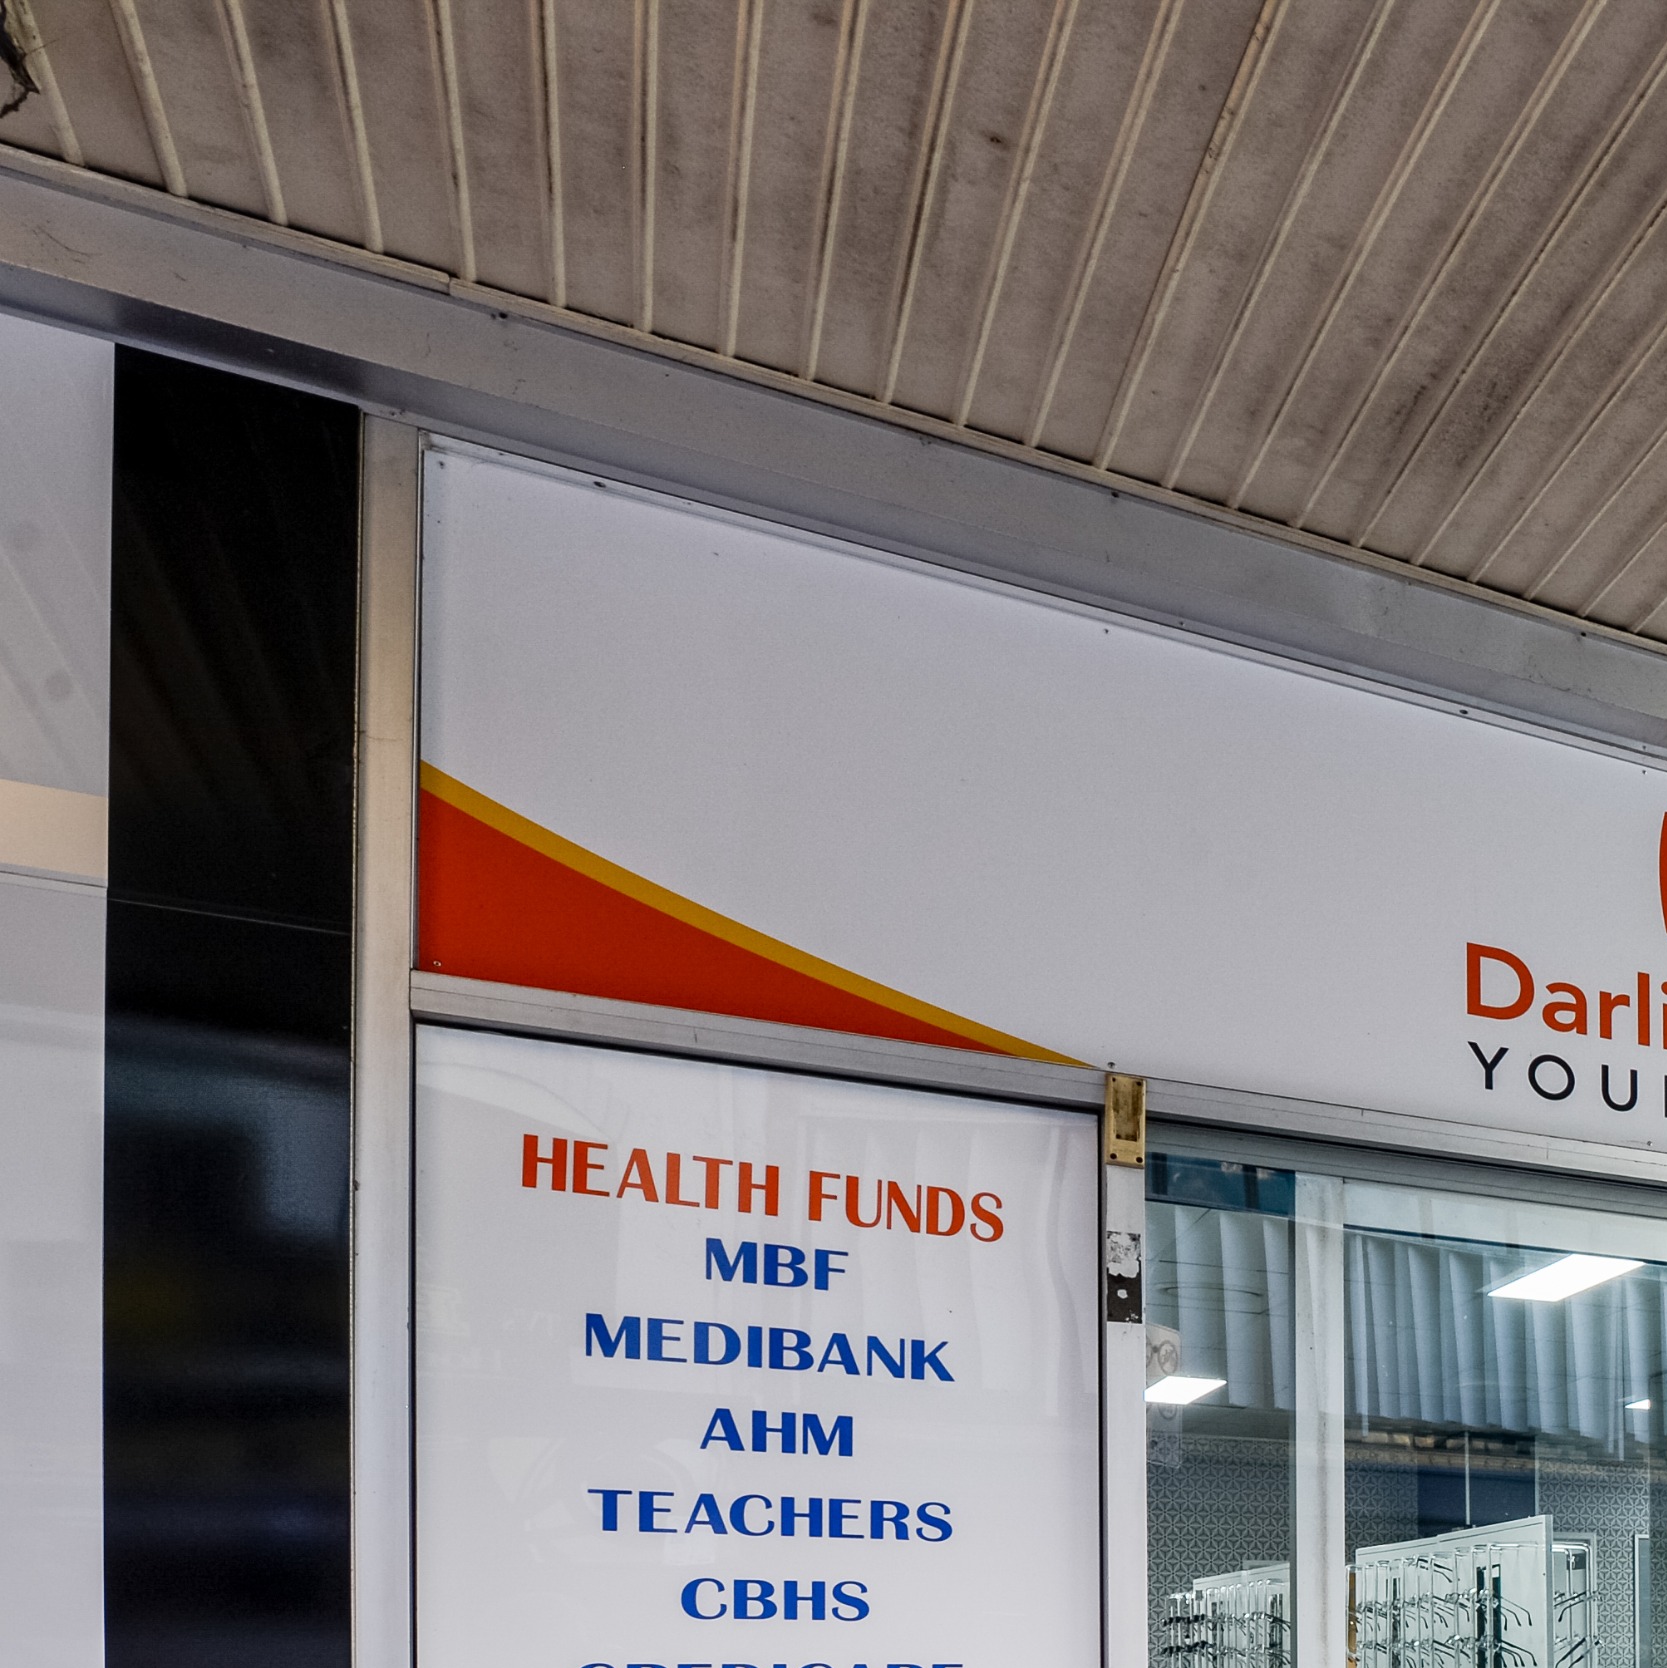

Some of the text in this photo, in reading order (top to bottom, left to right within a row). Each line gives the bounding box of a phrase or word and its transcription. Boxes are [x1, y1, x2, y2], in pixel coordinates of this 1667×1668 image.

[522, 1133, 1005, 1243] HEALTH FUNDS
[705, 1238, 849, 1291] MBF
[585, 1312, 955, 1383] MEDIBANK
[700, 1408, 854, 1457] AHM
[587, 1488, 953, 1542] TEACHERS
[680, 1577, 870, 1621] CBHS
